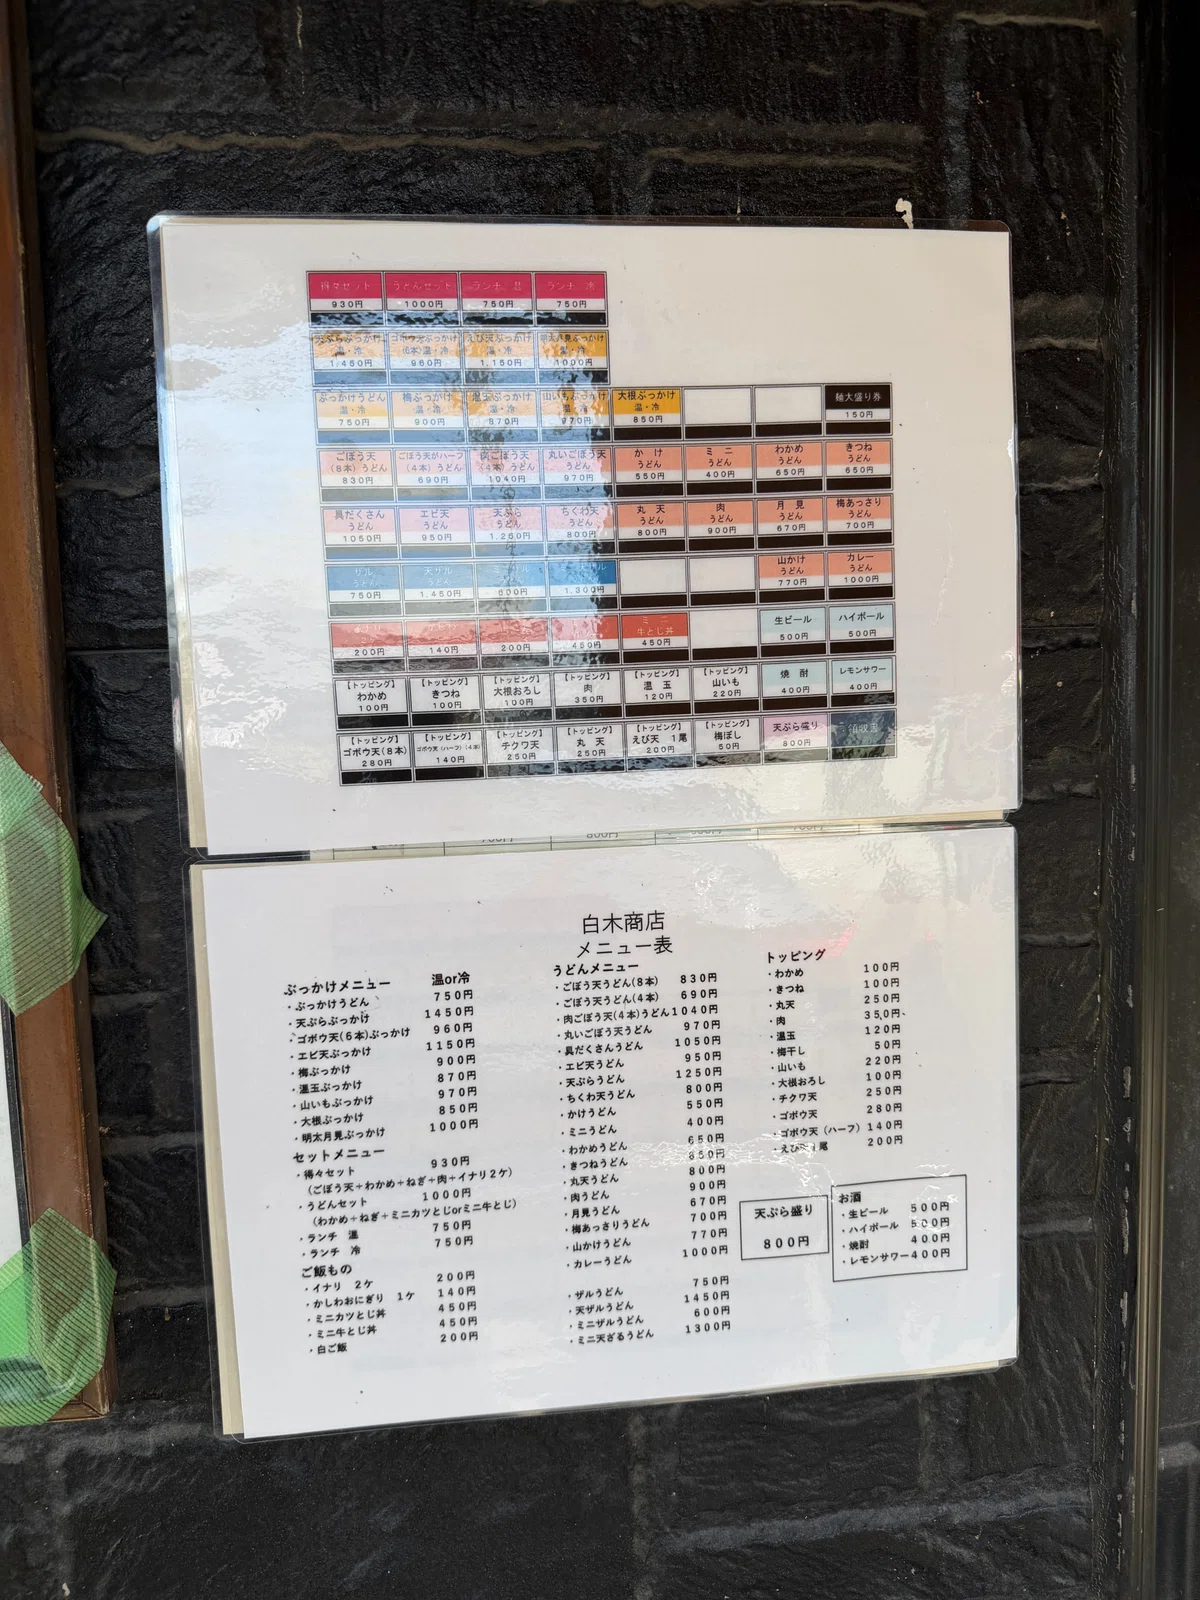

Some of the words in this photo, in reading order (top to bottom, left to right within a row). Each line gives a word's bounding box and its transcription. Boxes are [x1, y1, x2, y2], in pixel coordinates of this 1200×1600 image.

[332, 300, 362, 308] 930円
[404, 300, 442, 308] 1000円
[483, 300, 514, 308] 750円
[557, 300, 587, 308] 750円
[618, 390, 675, 400] 大根ぶっかけ
[845, 410, 872, 418] 150円
[774, 444, 803, 454] わかめ
[846, 442, 872, 452] きつね
[706, 470, 735, 478] 400円
[776, 468, 804, 476] 650円
[845, 466, 873, 474] 650円
[636, 472, 664, 480] 550円
[716, 503, 725, 512] 肉
[836, 498, 881, 508] 梅あっさり
[848, 509, 871, 518] うどん
[708, 526, 736, 534] 900円
[846, 521, 874, 529] 700円
[778, 555, 805, 565] 山かけ
[847, 553, 874, 562] カレー
[780, 566, 804, 575] うどん
[778, 578, 807, 586] 770円
[844, 575, 879, 583] 1000円
[774, 616, 812, 625] 生ビール
[839, 612, 884, 622] ハイボール
[780, 632, 808, 640] 500円
[848, 629, 876, 637] 500円
[642, 639, 671, 647] 450円
[840, 666, 886, 675] レモンサワー
[712, 678, 740, 687] 山いも
[850, 682, 878, 690] 400円
[432, 689, 460, 699] きつね
[493, 686, 541, 696] 大根おろし
[713, 689, 741, 697] 220円
[781, 686, 810, 694] 400円
[357, 691, 387, 702] わかめ
[644, 692, 672, 700] 120円
[359, 704, 388, 712] 100円
[433, 701, 462, 709] 100円
[773, 721, 819, 732] 天ぷら盛り
[502, 740, 540, 750] チクワ天
[718, 742, 739, 750] 50円
[782, 739, 811, 747] 800円
[436, 756, 465, 764] 140円
[507, 752, 536, 760] 250円
[361, 759, 392, 767] 280円
[582, 910, 665, 935] 白木商店
[577, 935, 673, 958] メニュー表
[767, 949, 826, 963] トッピング
[554, 963, 639, 976] うどんメニュー
[864, 962, 899, 972] 100円
[284, 980, 390, 995] ぶっかけメニュー
[431, 971, 470, 986] 温or冷
[681, 973, 717, 984] 830円
[864, 978, 899, 988] 100円
[434, 990, 473, 1002] 750円
[681, 989, 718, 999] 690円
[865, 994, 900, 1004] 250円
[425, 1006, 473, 1018] 1450円
[672, 1005, 718, 1016] 1040円
[434, 1023, 472, 1034] 960円
[684, 1020, 720, 1031] 970円
[865, 1024, 900, 1034] 120円
[426, 1039, 475, 1050] 1150円
[675, 1036, 720, 1047] 1050円
[875, 1040, 900, 1049] 50円
[437, 1055, 476, 1067] 900円
[685, 1051, 721, 1062] 950円
[866, 1055, 901, 1065] 220円
[438, 1071, 476, 1083] 870円
[676, 1067, 722, 1078] 1250円
[867, 1070, 901, 1081] 100円
[438, 1087, 477, 1098] 970円
[686, 1083, 722, 1094] 800円
[867, 1086, 901, 1096] 250円
[687, 1098, 723, 1109] 550円
[867, 1103, 902, 1113] 280円
[439, 1103, 478, 1115] 850円
[430, 1119, 478, 1131] 1000円
[687, 1116, 724, 1126] 400円
[868, 1120, 902, 1131] 140円
[868, 1135, 903, 1146] 200円
[293, 1149, 385, 1163] セットメニュー
[431, 1156, 470, 1168] 930円
[690, 1165, 725, 1175] 800円
[690, 1180, 726, 1191] 900円
[423, 1188, 471, 1201] 1000円
[839, 1192, 861, 1203] お酒
[691, 1195, 726, 1206] 670円
[755, 1204, 813, 1219] 天ぷら盛り
[911, 1202, 949, 1213] 500円
[691, 1211, 727, 1222] 700円
[433, 1220, 471, 1232] 750円
[692, 1228, 727, 1239] 770円
[911, 1233, 950, 1244] 400円
[435, 1236, 473, 1247] 750円
[764, 1237, 809, 1249] 800円
[682, 1245, 728, 1257] 1000円
[911, 1249, 950, 1259] 400円
[302, 1264, 352, 1278] ご飯もの
[437, 1271, 475, 1282] 200円
[693, 1276, 729, 1286] 750円
[438, 1286, 476, 1298] 140円
[684, 1291, 730, 1302] 1450円
[438, 1301, 476, 1312] 450円
[695, 1306, 730, 1317] 600円
[440, 1317, 477, 1328] 450円
[685, 1321, 730, 1333] 1300円
[441, 1332, 478, 1343] 200円
